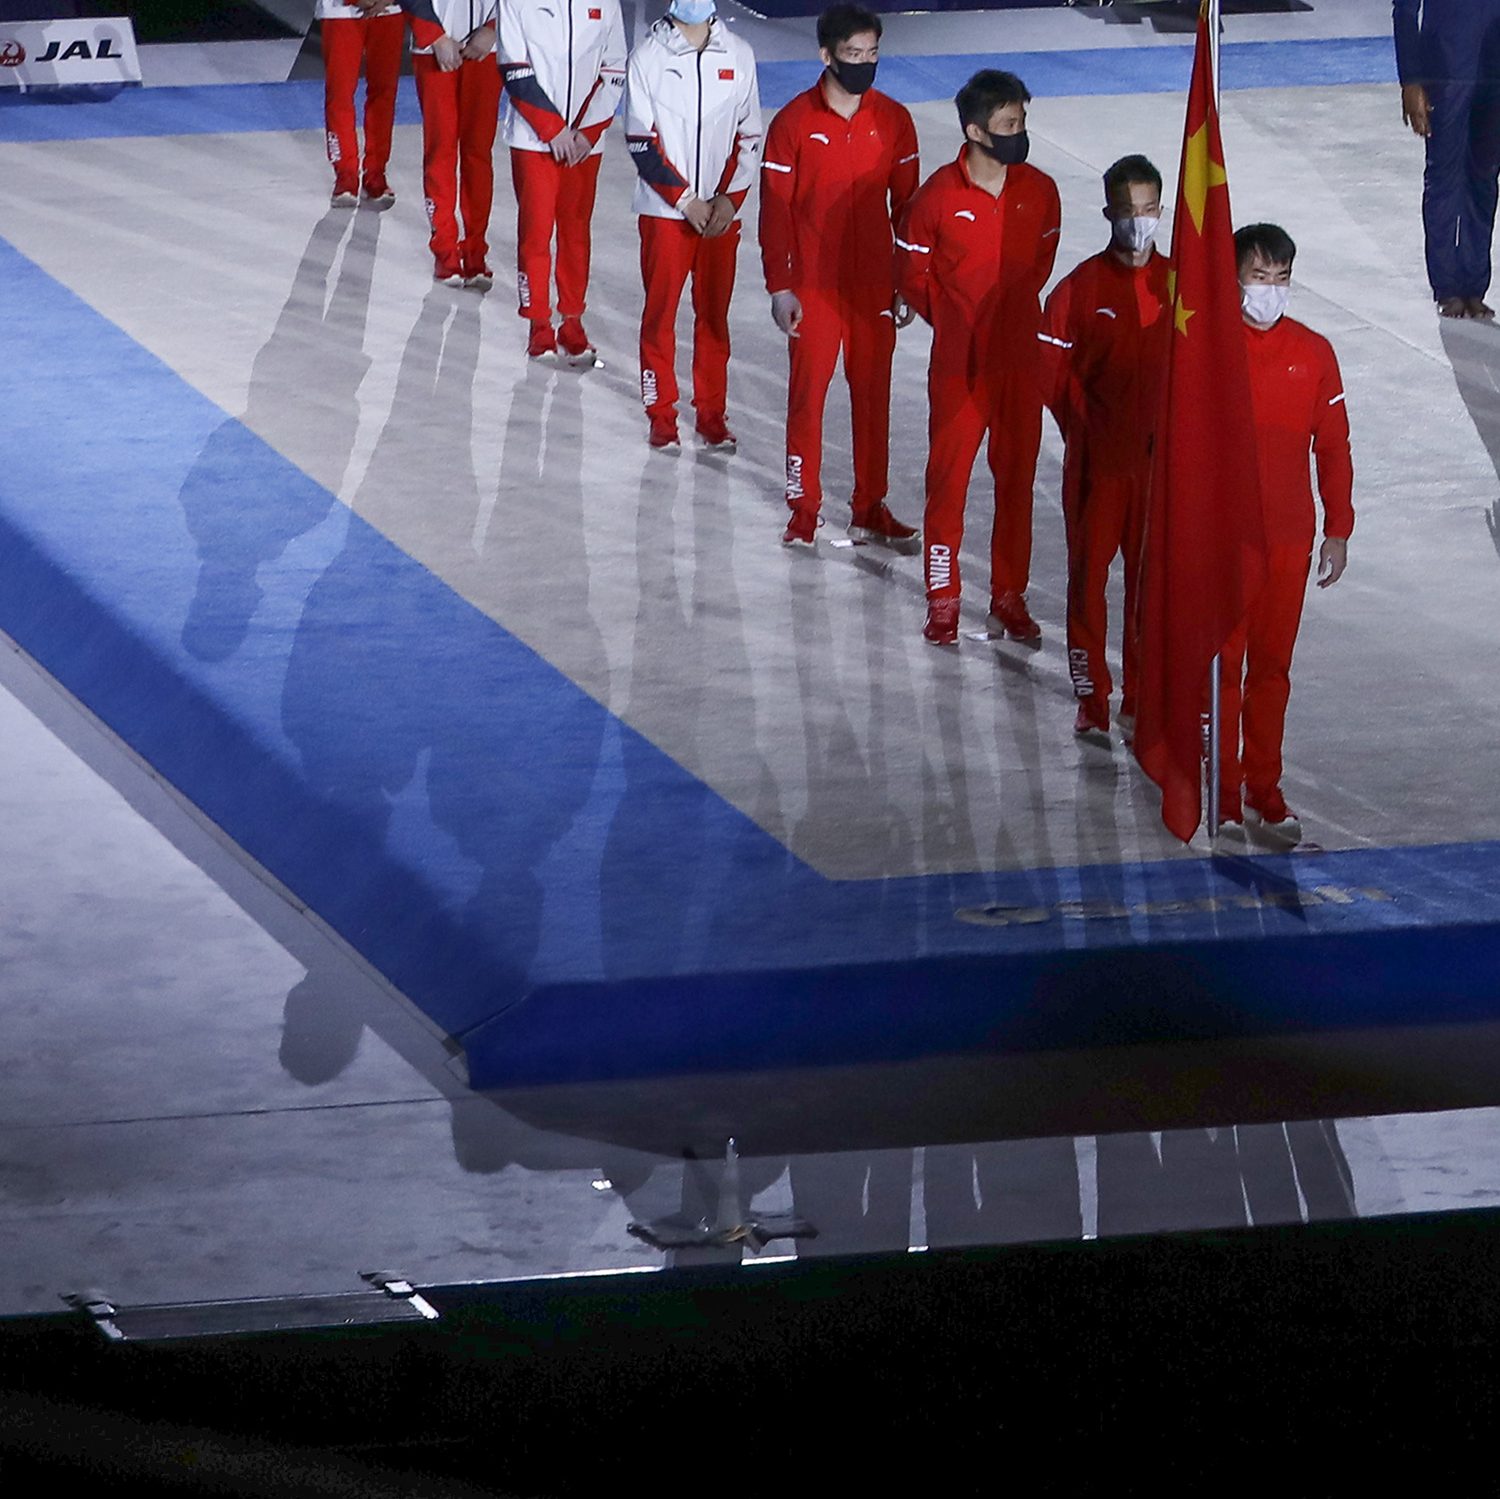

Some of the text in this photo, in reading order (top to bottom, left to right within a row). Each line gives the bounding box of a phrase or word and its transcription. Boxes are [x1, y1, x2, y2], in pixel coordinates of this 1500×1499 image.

[34, 39, 122, 62] JAL
[787, 455, 805, 500] CHINA
[930, 544, 951, 591] CHINA
[1070, 649, 1095, 696] CHINA
